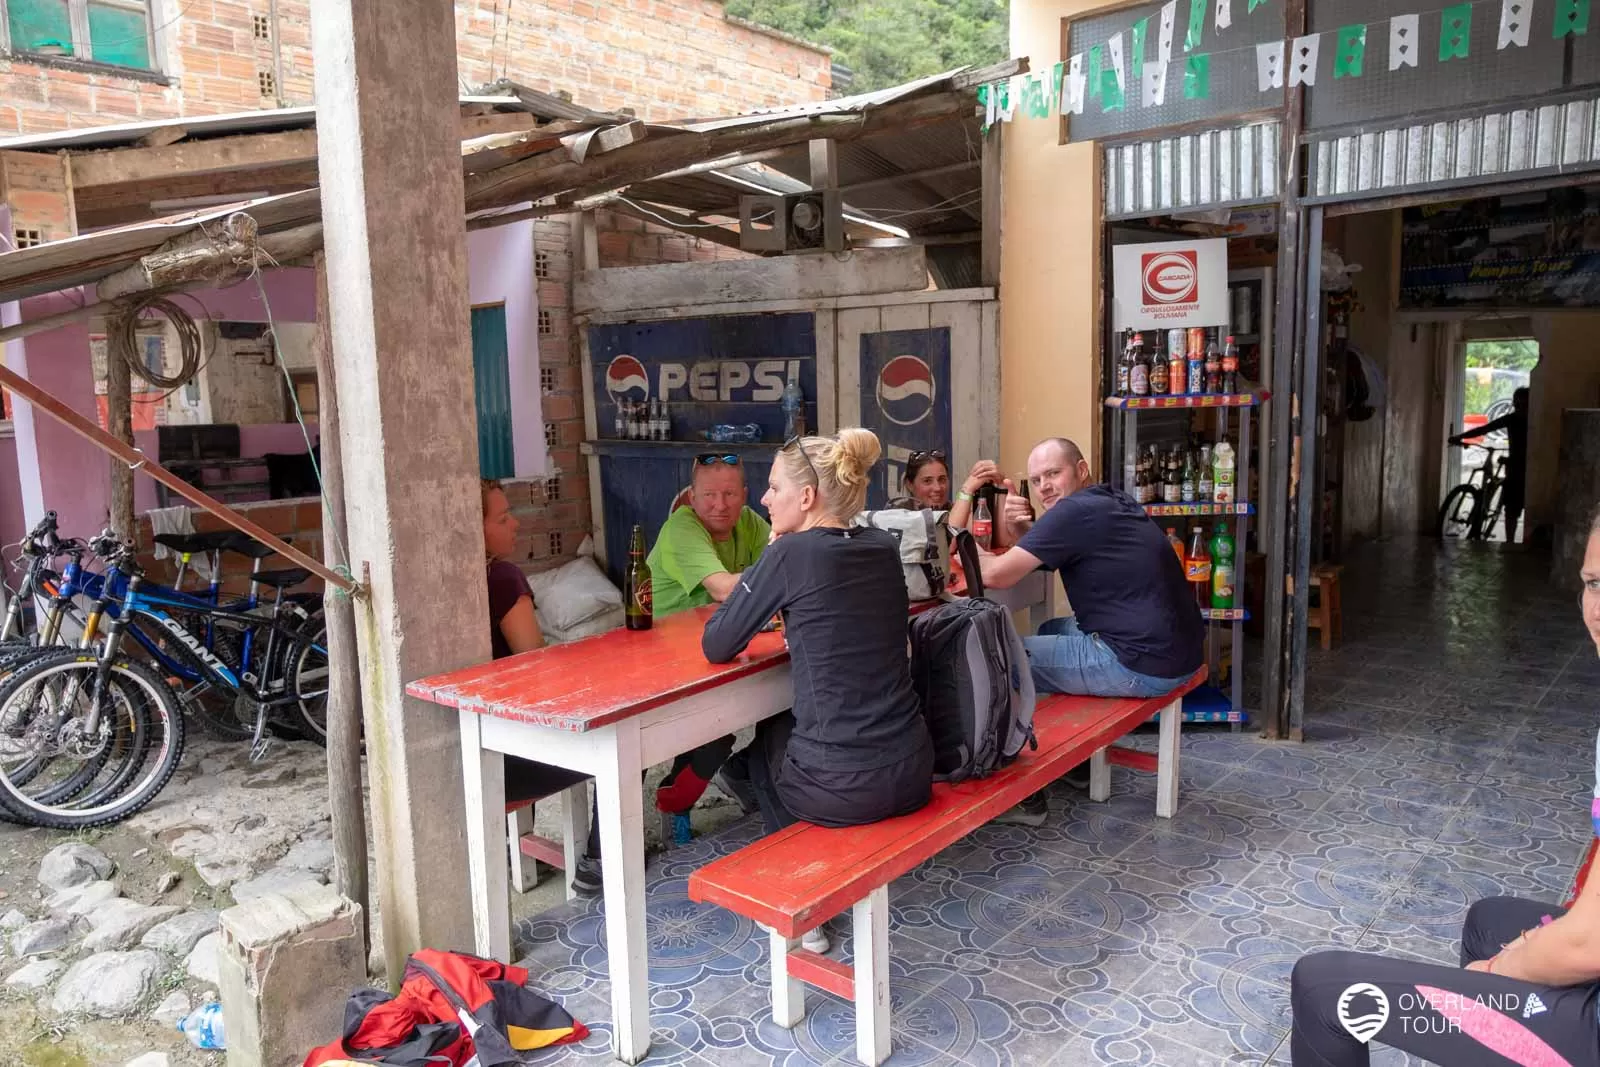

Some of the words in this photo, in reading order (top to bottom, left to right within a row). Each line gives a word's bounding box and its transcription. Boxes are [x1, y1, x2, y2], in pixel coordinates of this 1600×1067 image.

[1532, 259, 1574, 273] Tours
[659, 359, 800, 402] PEPSI
[163, 618, 228, 670] GIANT
